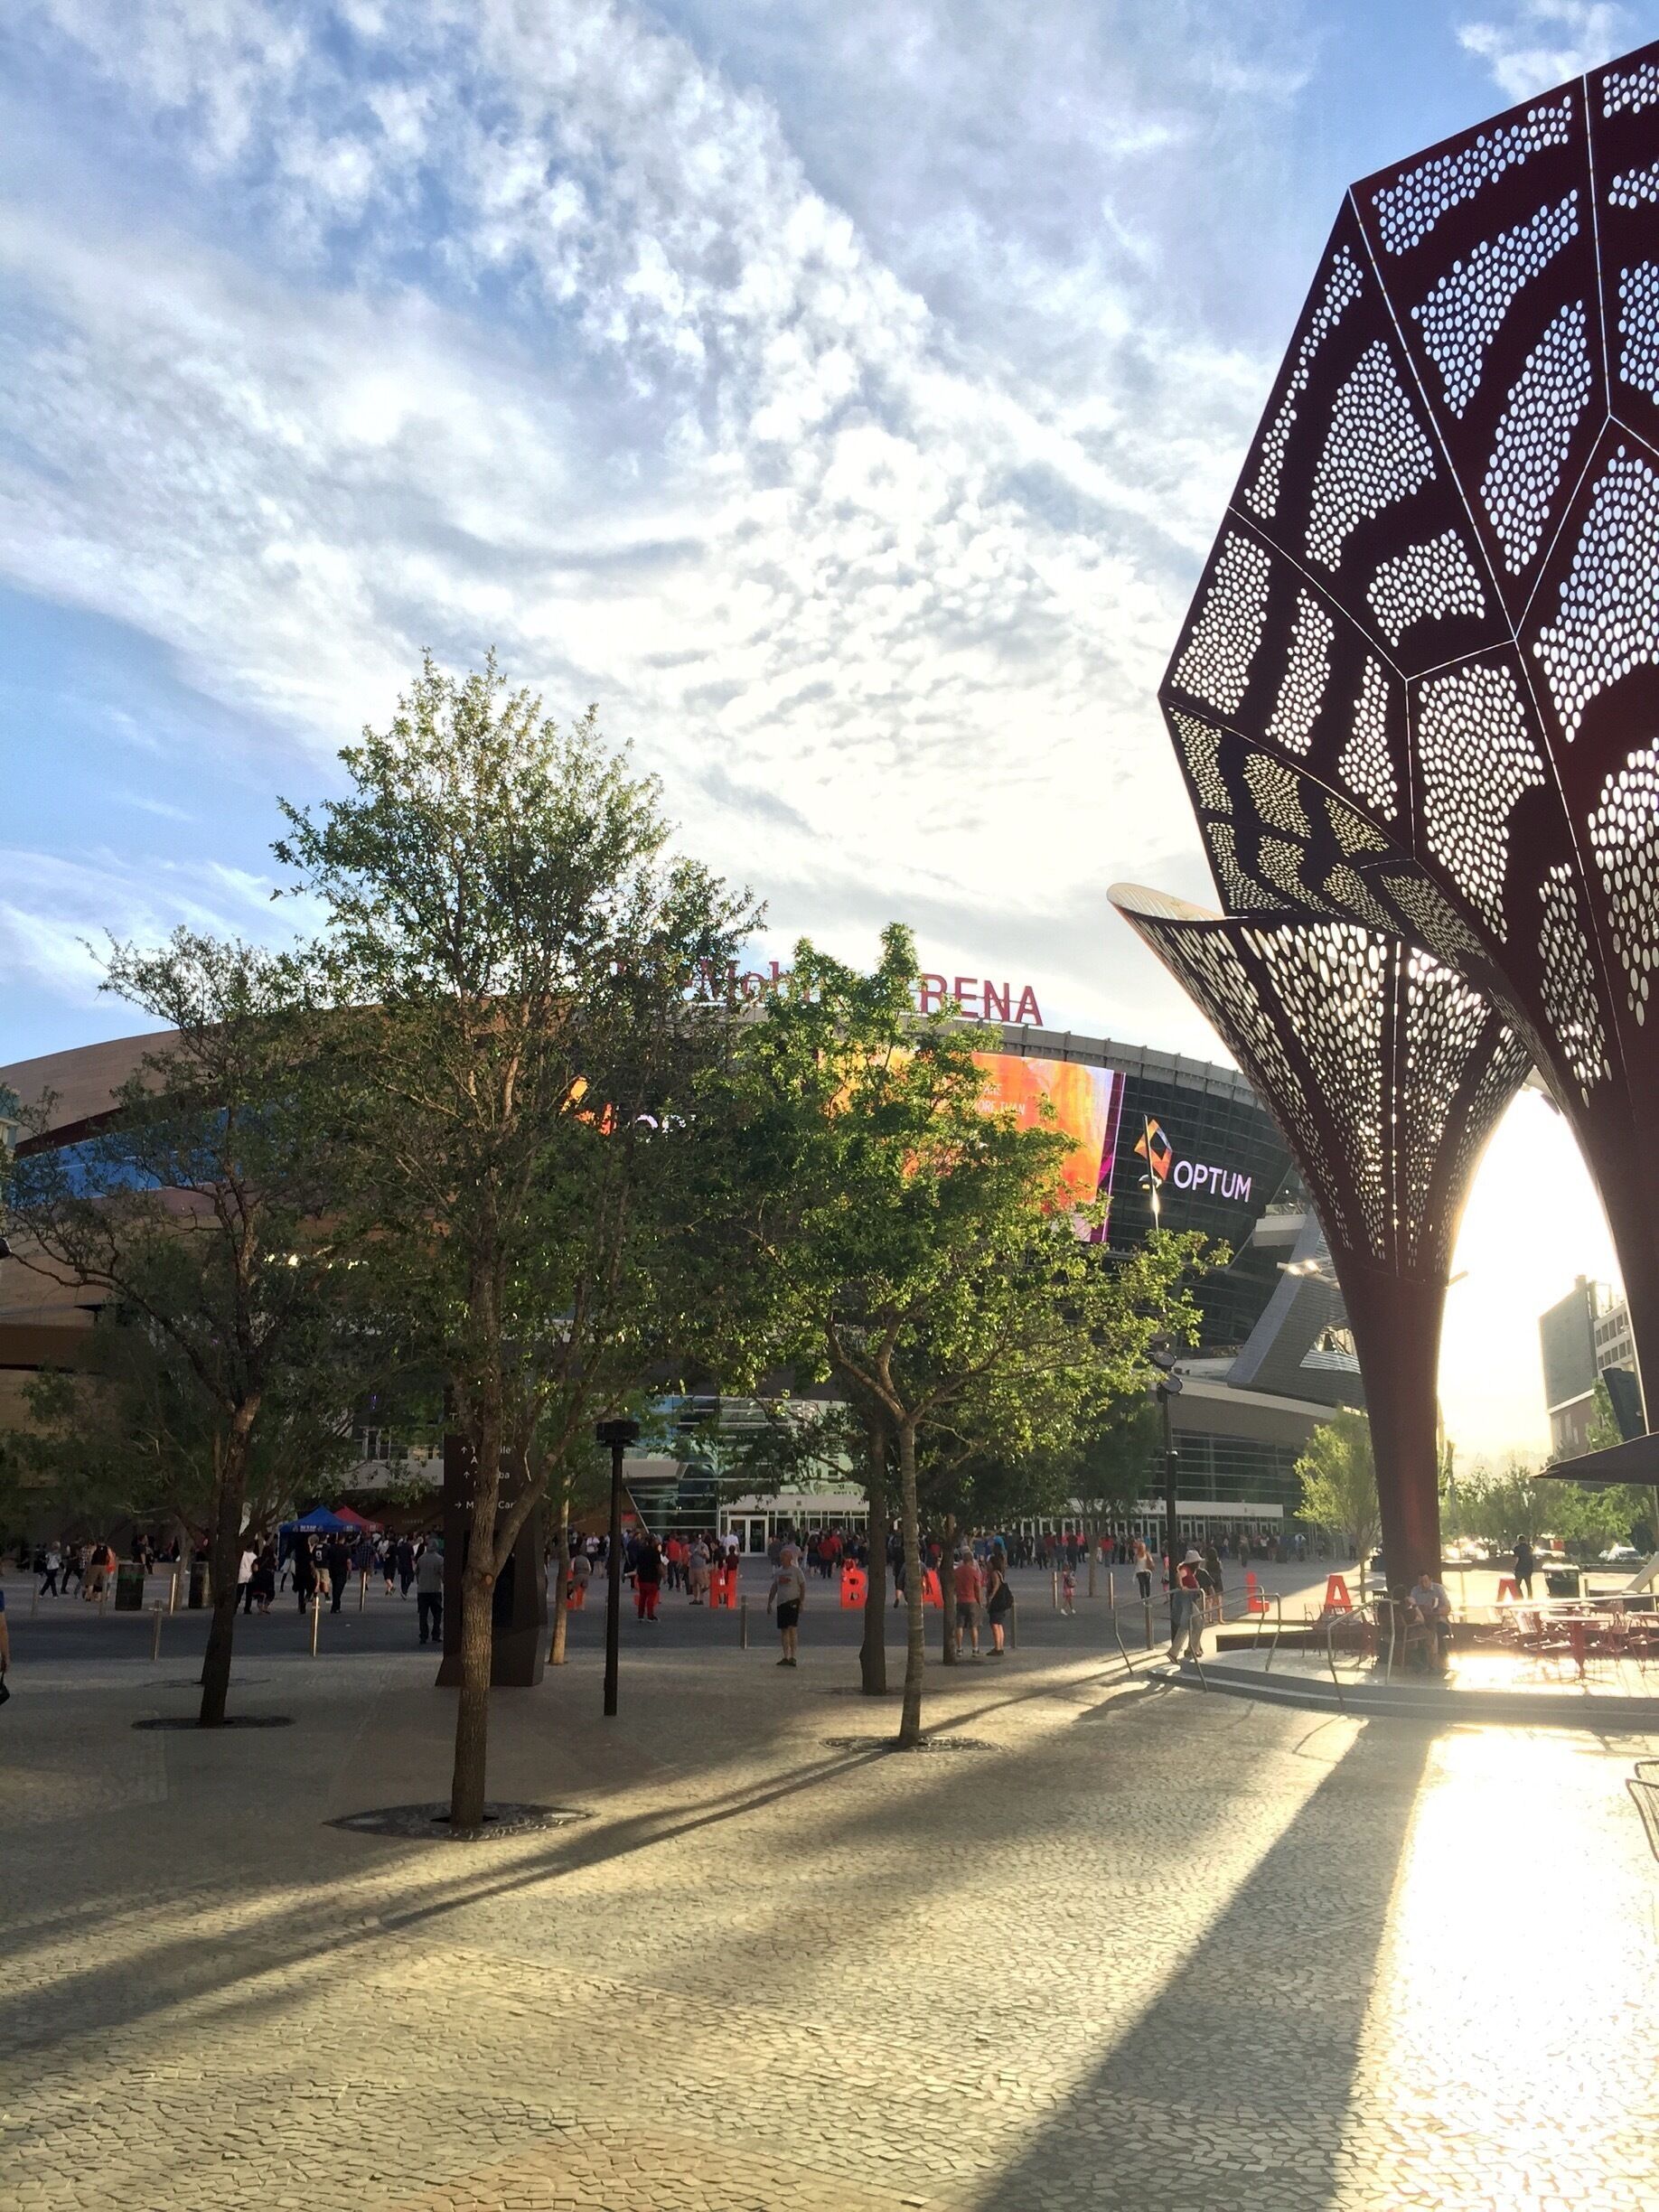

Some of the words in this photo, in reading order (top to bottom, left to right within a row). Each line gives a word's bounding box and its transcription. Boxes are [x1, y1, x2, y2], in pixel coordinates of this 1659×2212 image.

[920, 973, 1044, 1026] RENA
[1174, 1160, 1251, 1203] OPTUM
[498, 1500, 517, 1510] Car
